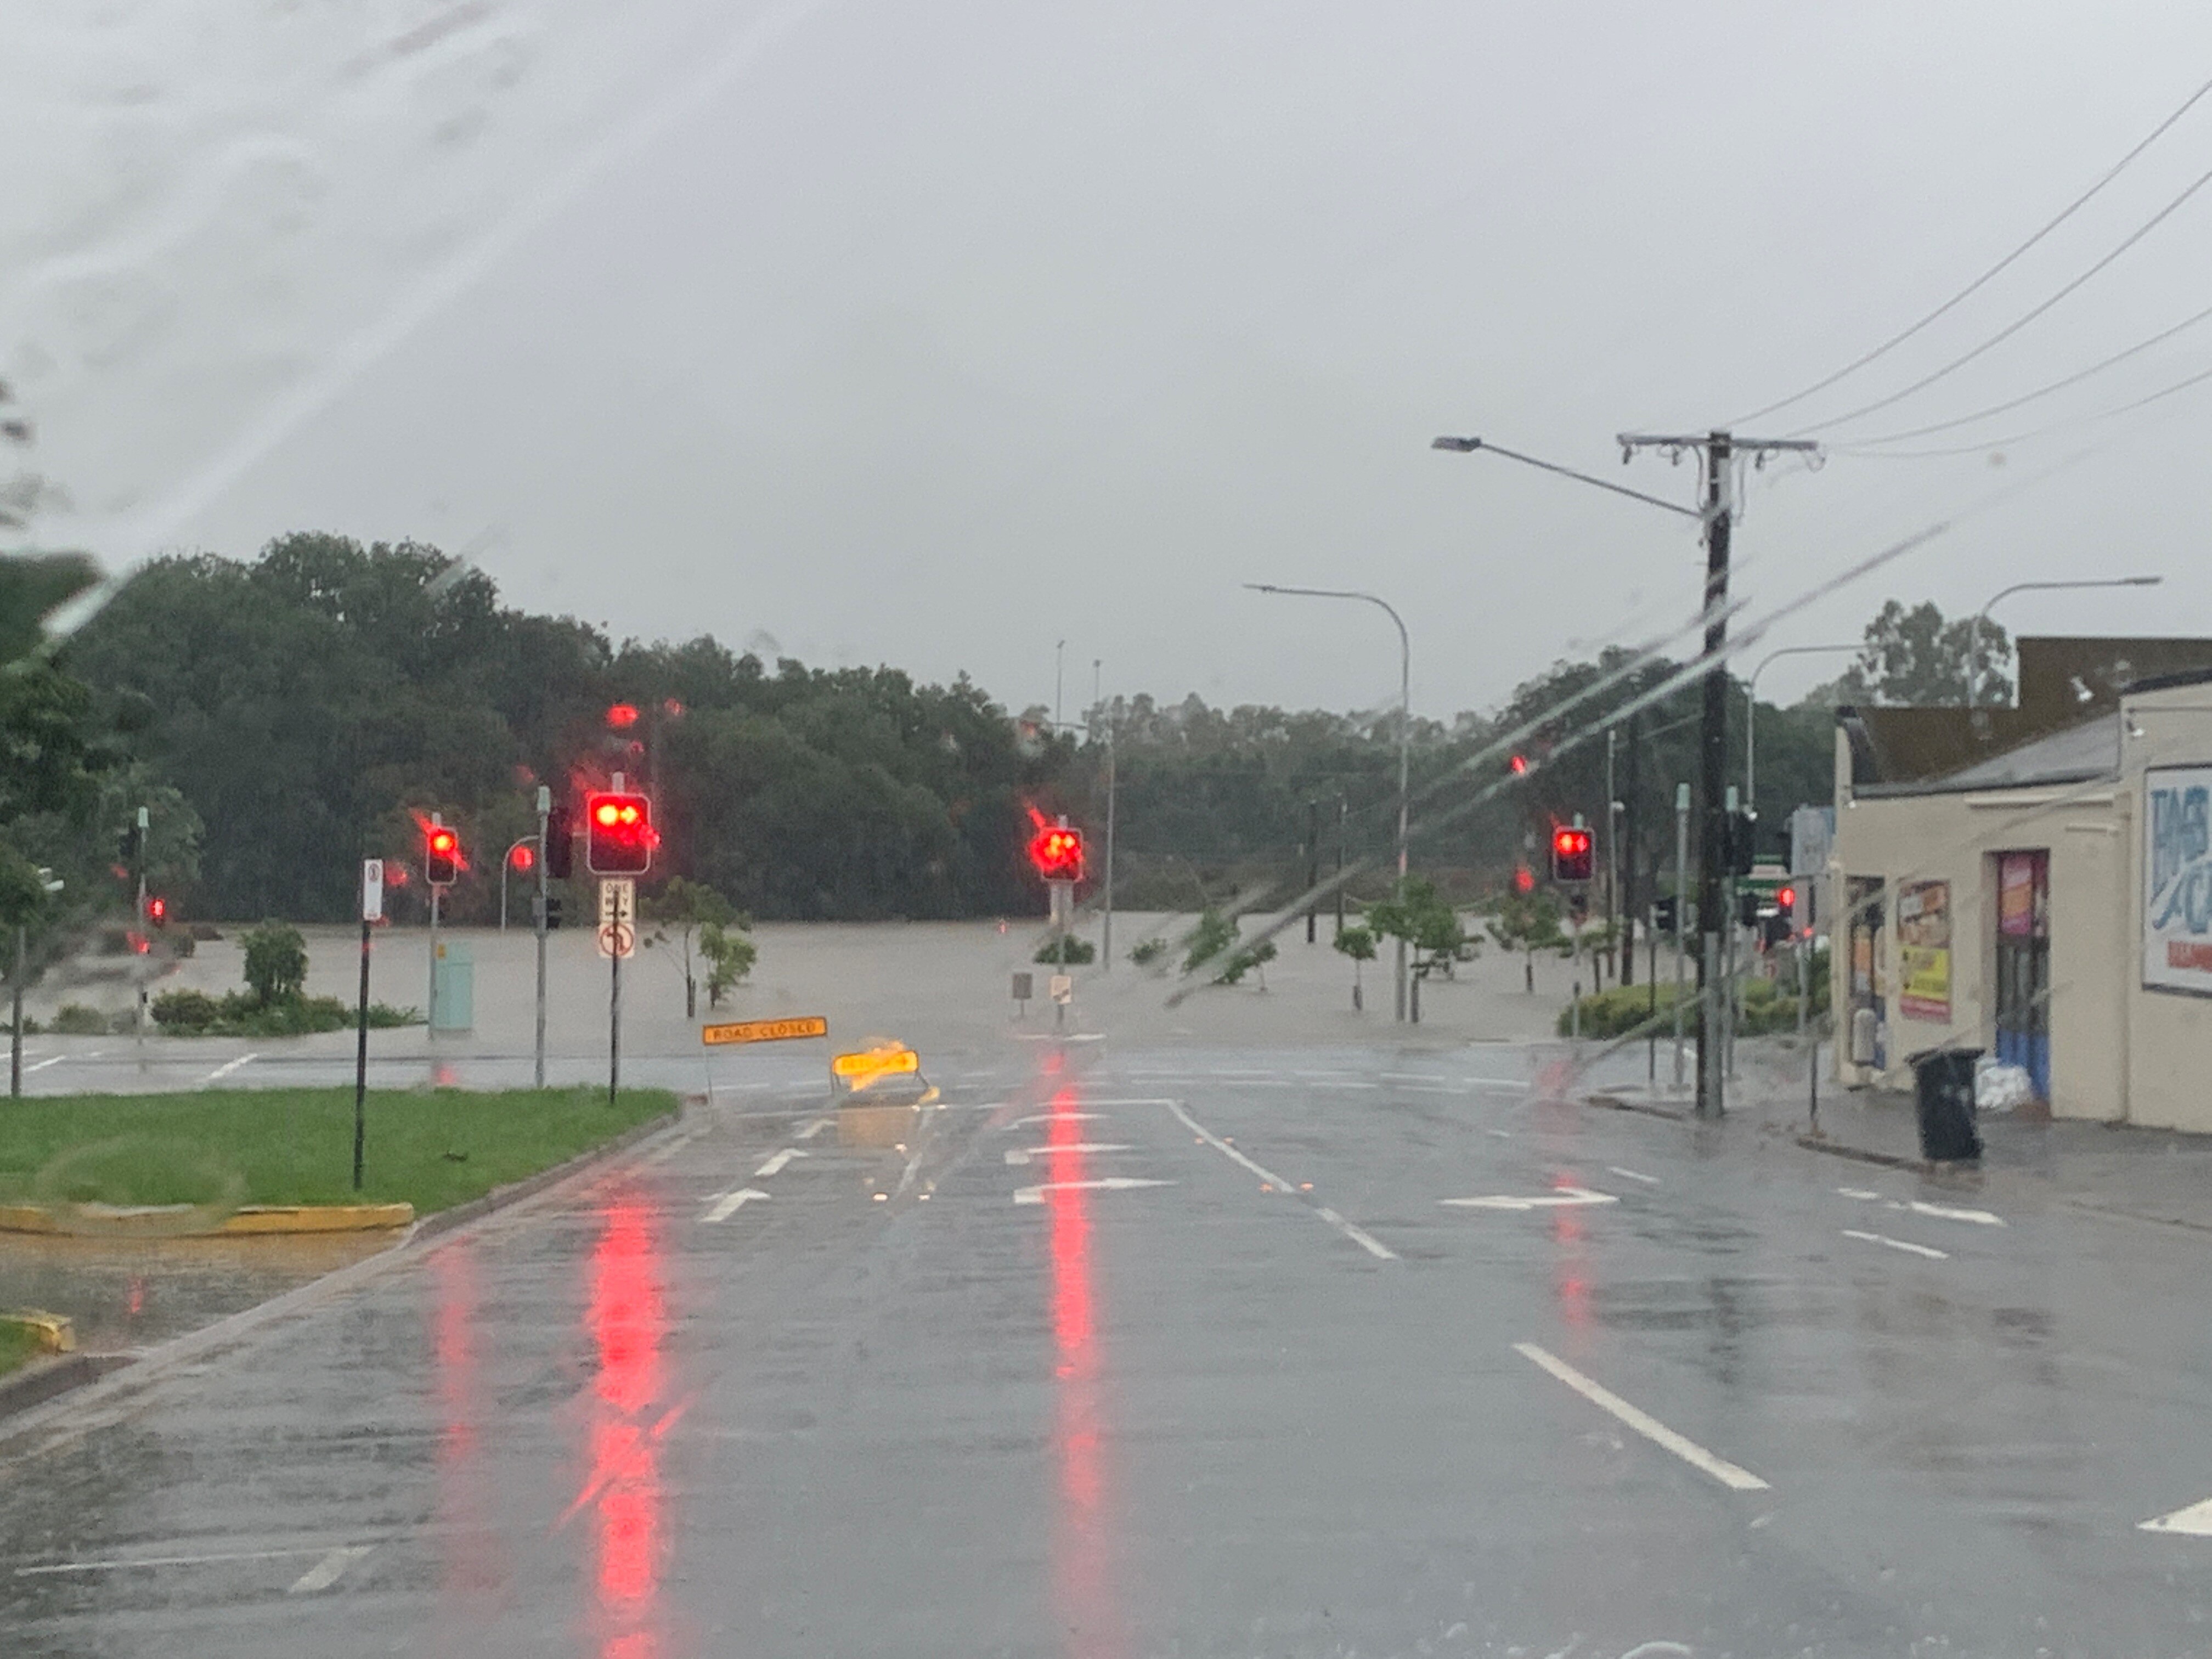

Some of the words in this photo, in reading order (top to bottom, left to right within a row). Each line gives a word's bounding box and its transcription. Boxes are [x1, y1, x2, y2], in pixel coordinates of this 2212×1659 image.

[605, 897, 629, 906] WY
[714, 1026, 753, 1040] ROAD
[759, 1020, 816, 1037] CLOSED
